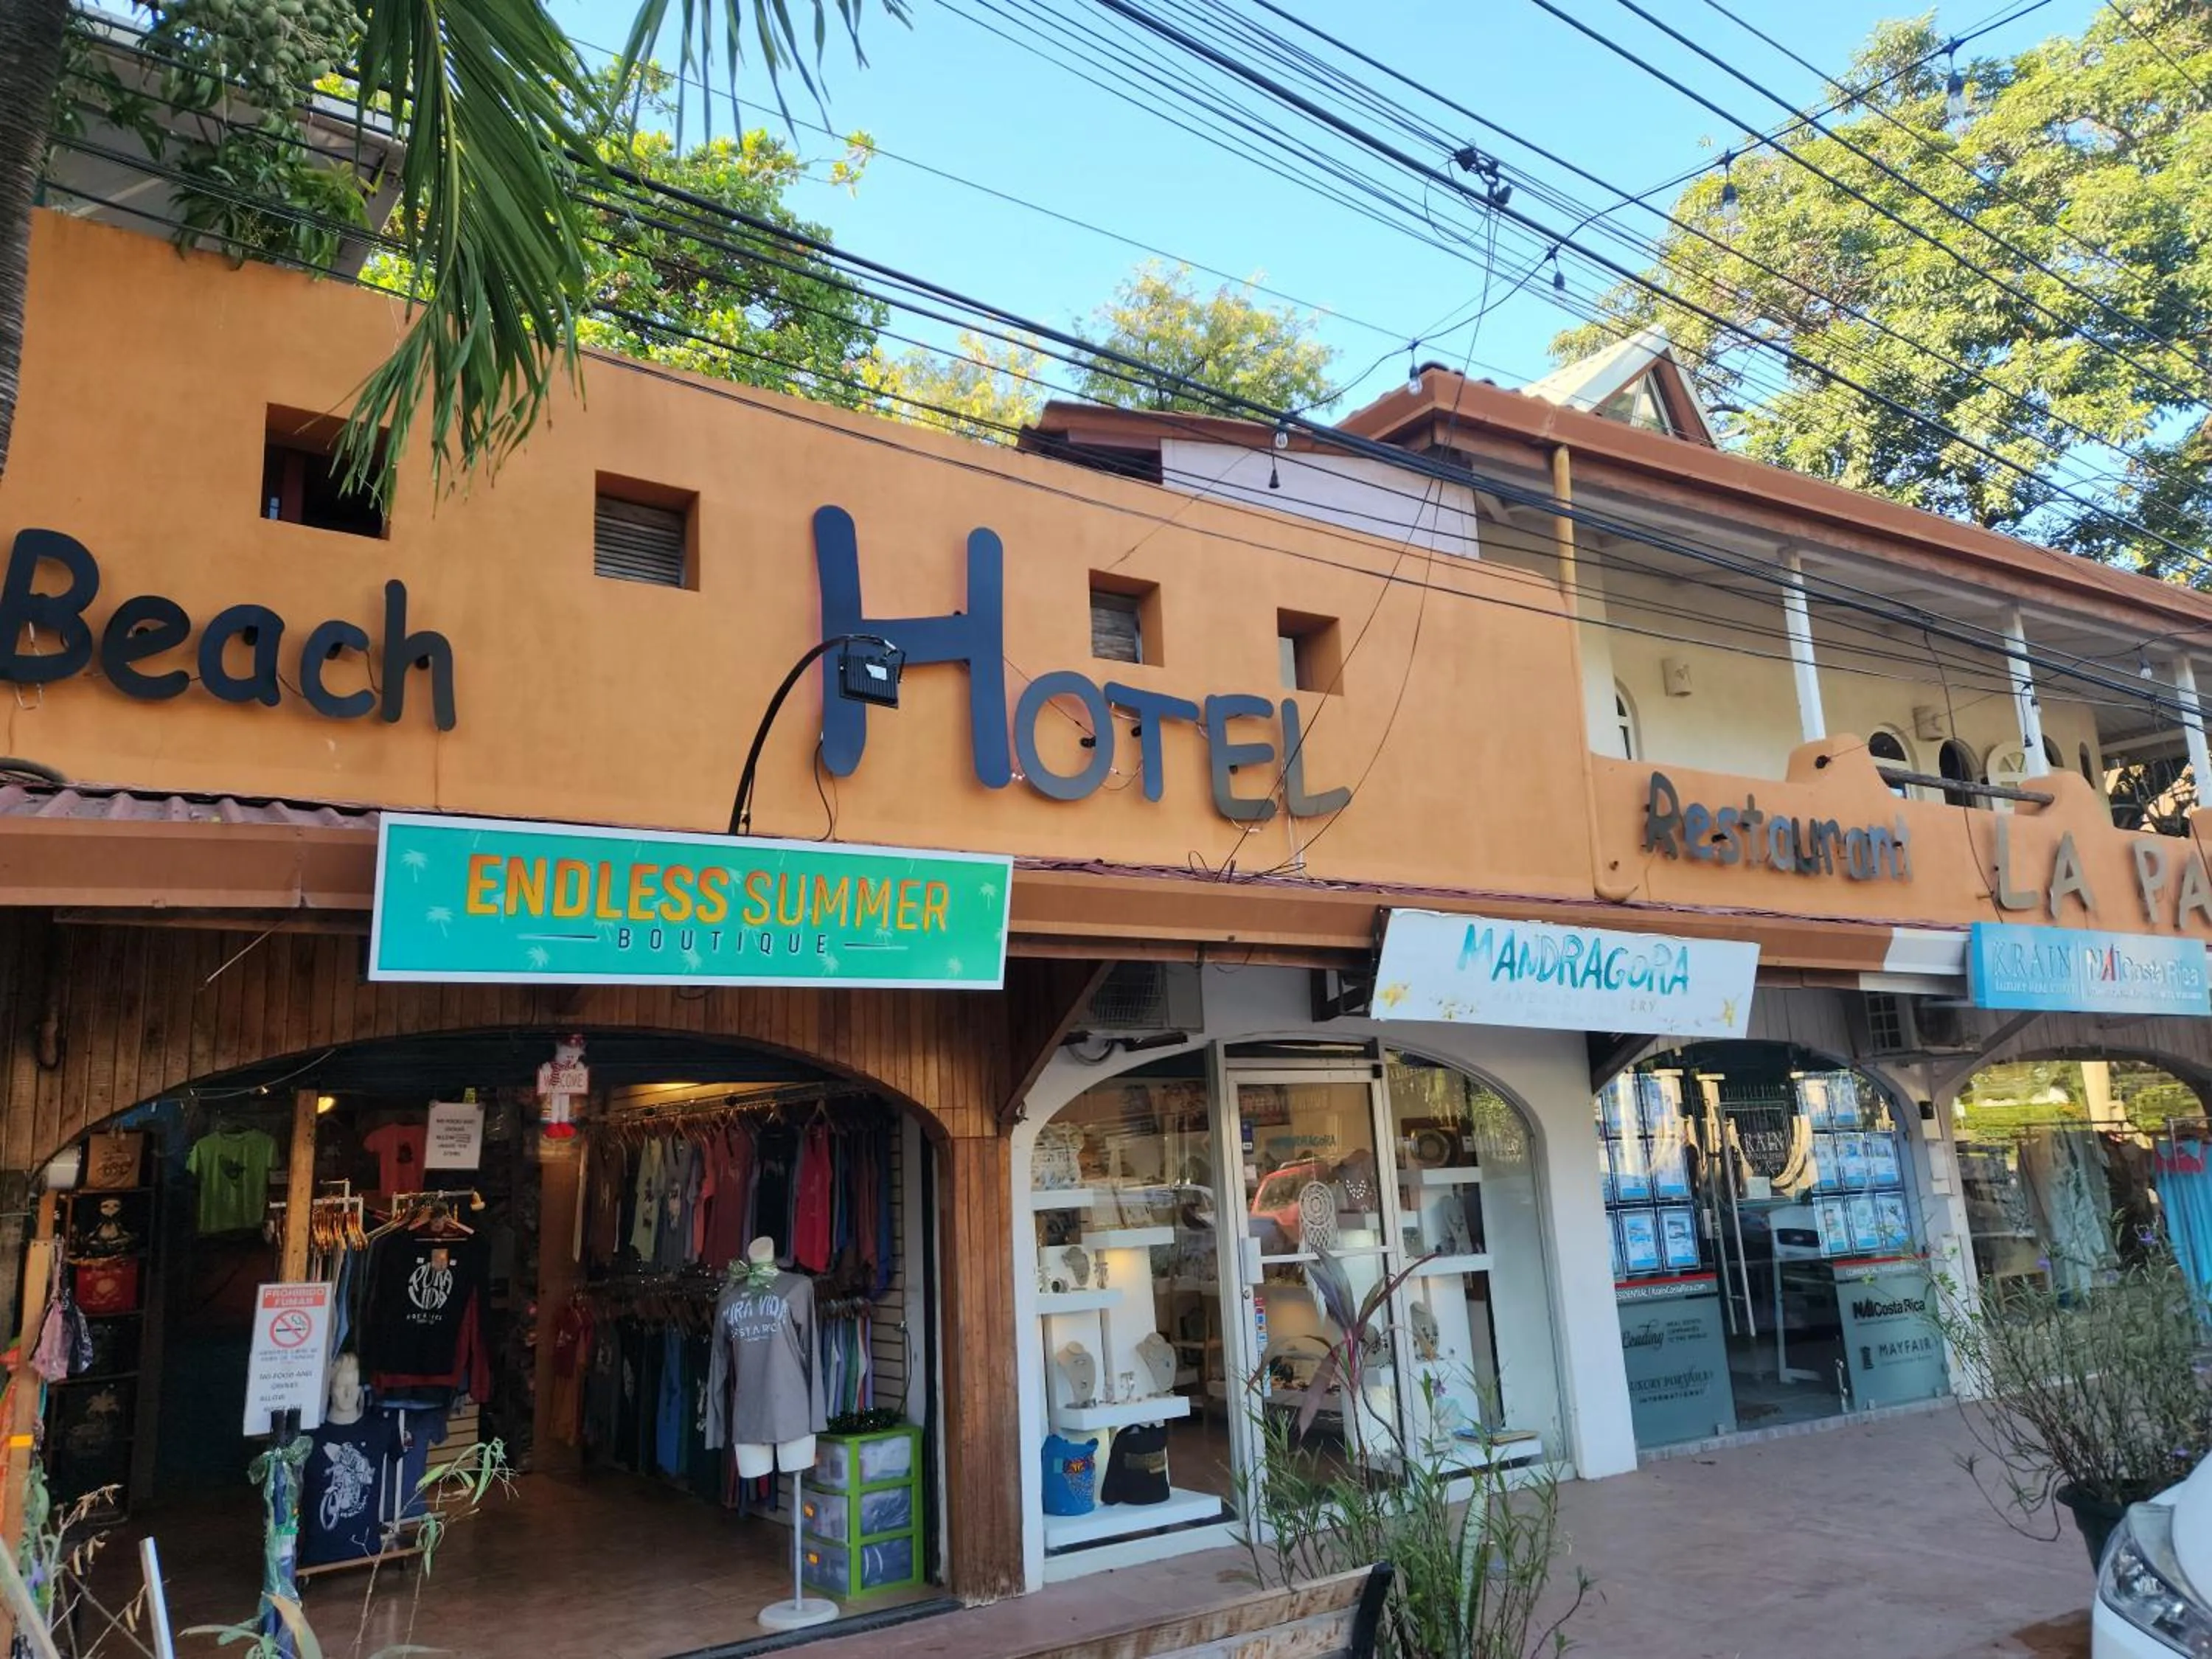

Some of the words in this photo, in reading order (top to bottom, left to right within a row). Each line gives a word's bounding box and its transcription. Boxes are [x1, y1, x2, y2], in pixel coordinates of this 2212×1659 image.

[0, 527, 456, 731] Beach
[813, 504, 1352, 821] HOTEL
[1644, 771, 1914, 884] Restaurant
[467, 853, 729, 924] ENDLESS
[742, 870, 951, 933] SUMMER
[1994, 813, 2098, 922] LA
[618, 928, 827, 956] BOUTIQUE
[1456, 923, 1690, 995] MANDRAGORA
[1992, 942, 2073, 981] KRAIN
[265, 1287, 324, 1298] PROHIBIDO
[275, 1297, 314, 1307] FUMAR
[1878, 1337, 1933, 1357] MAYFAIR
